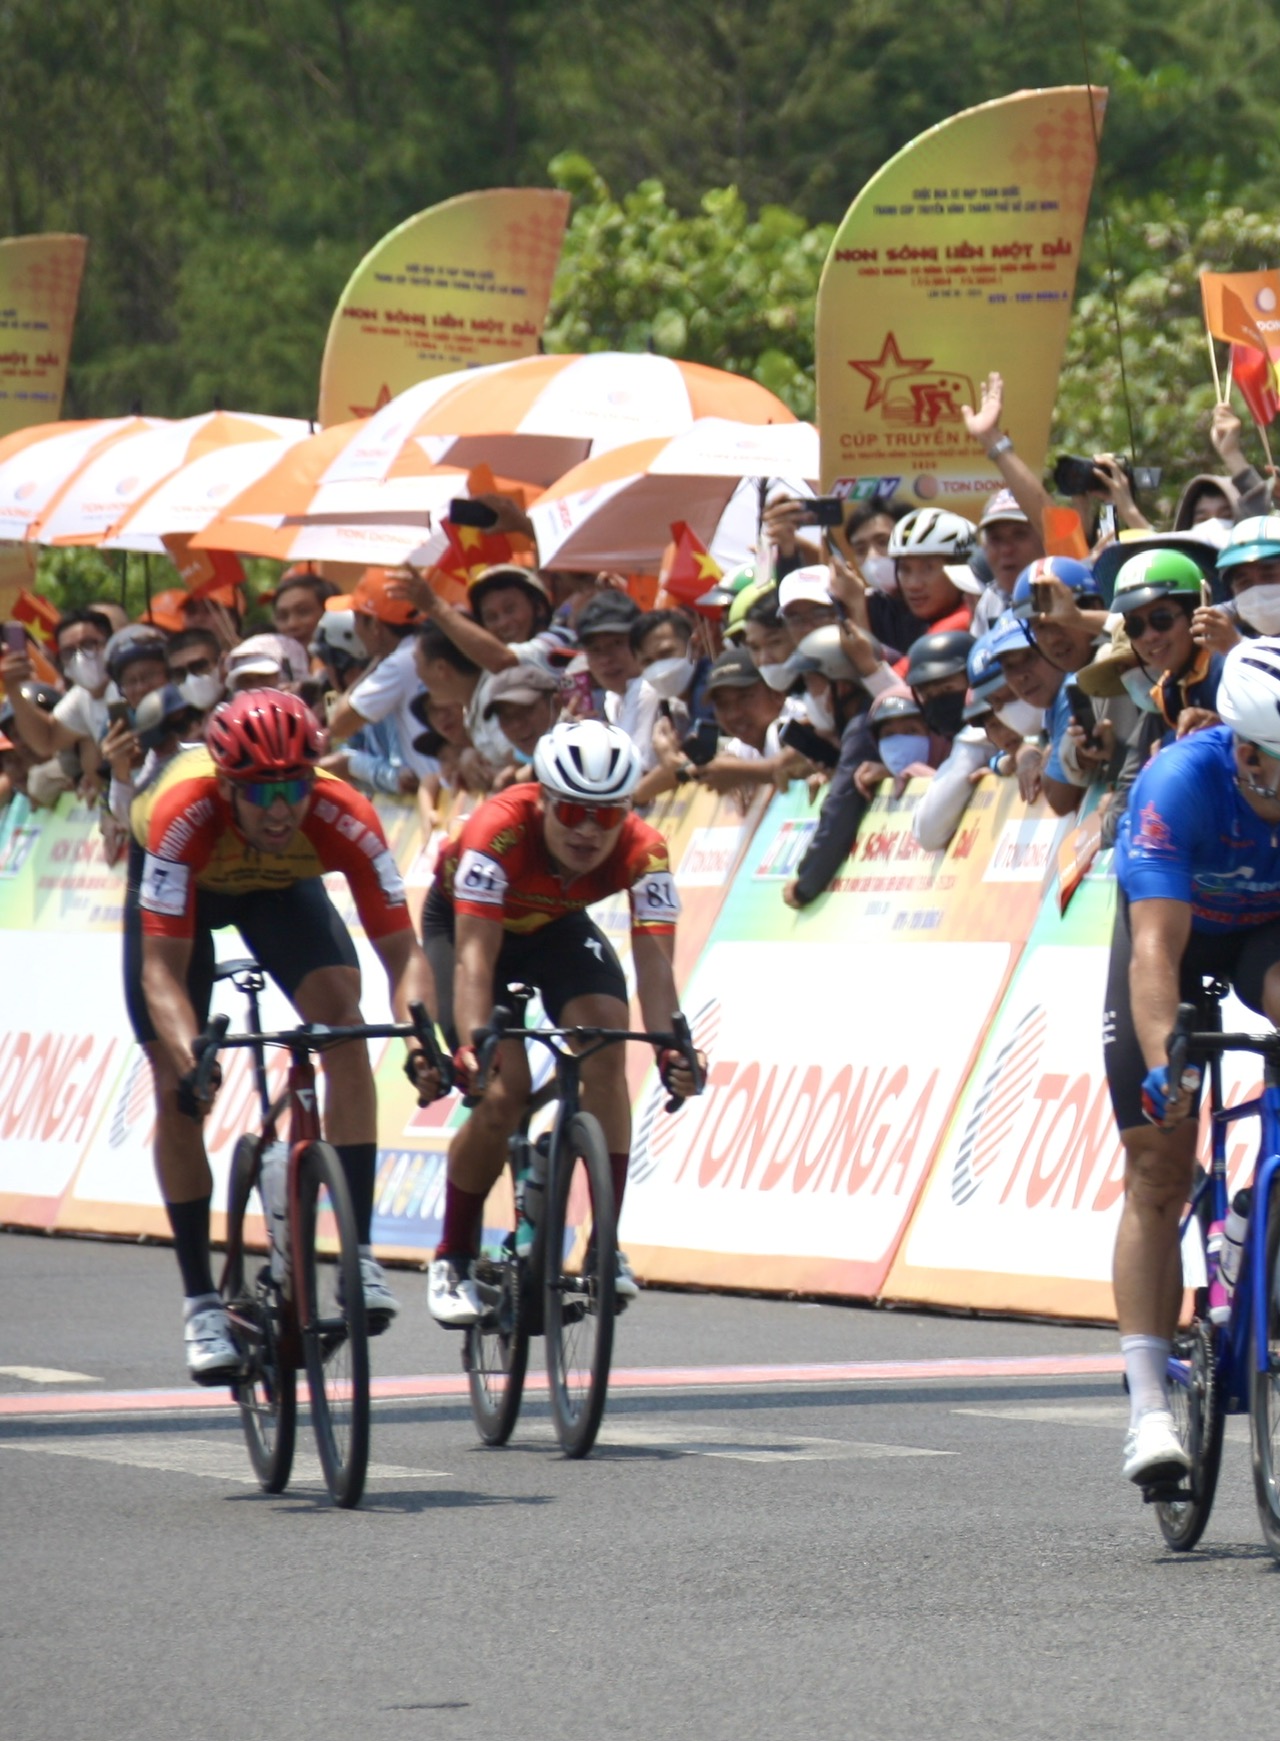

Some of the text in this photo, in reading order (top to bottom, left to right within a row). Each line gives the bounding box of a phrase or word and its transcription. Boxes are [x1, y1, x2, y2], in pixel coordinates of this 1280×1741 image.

[840, 433, 877, 448] CÚP
[885, 429, 959, 447] TRUYỀN
[831, 477, 900, 499] HTV
[942, 480, 971, 492] TON
[154, 866, 170, 897] 7
[464, 862, 496, 891] 81
[645, 881, 678, 909] 81
[675, 1061, 798, 1190] TON
[758, 1064, 909, 1196] DONG
